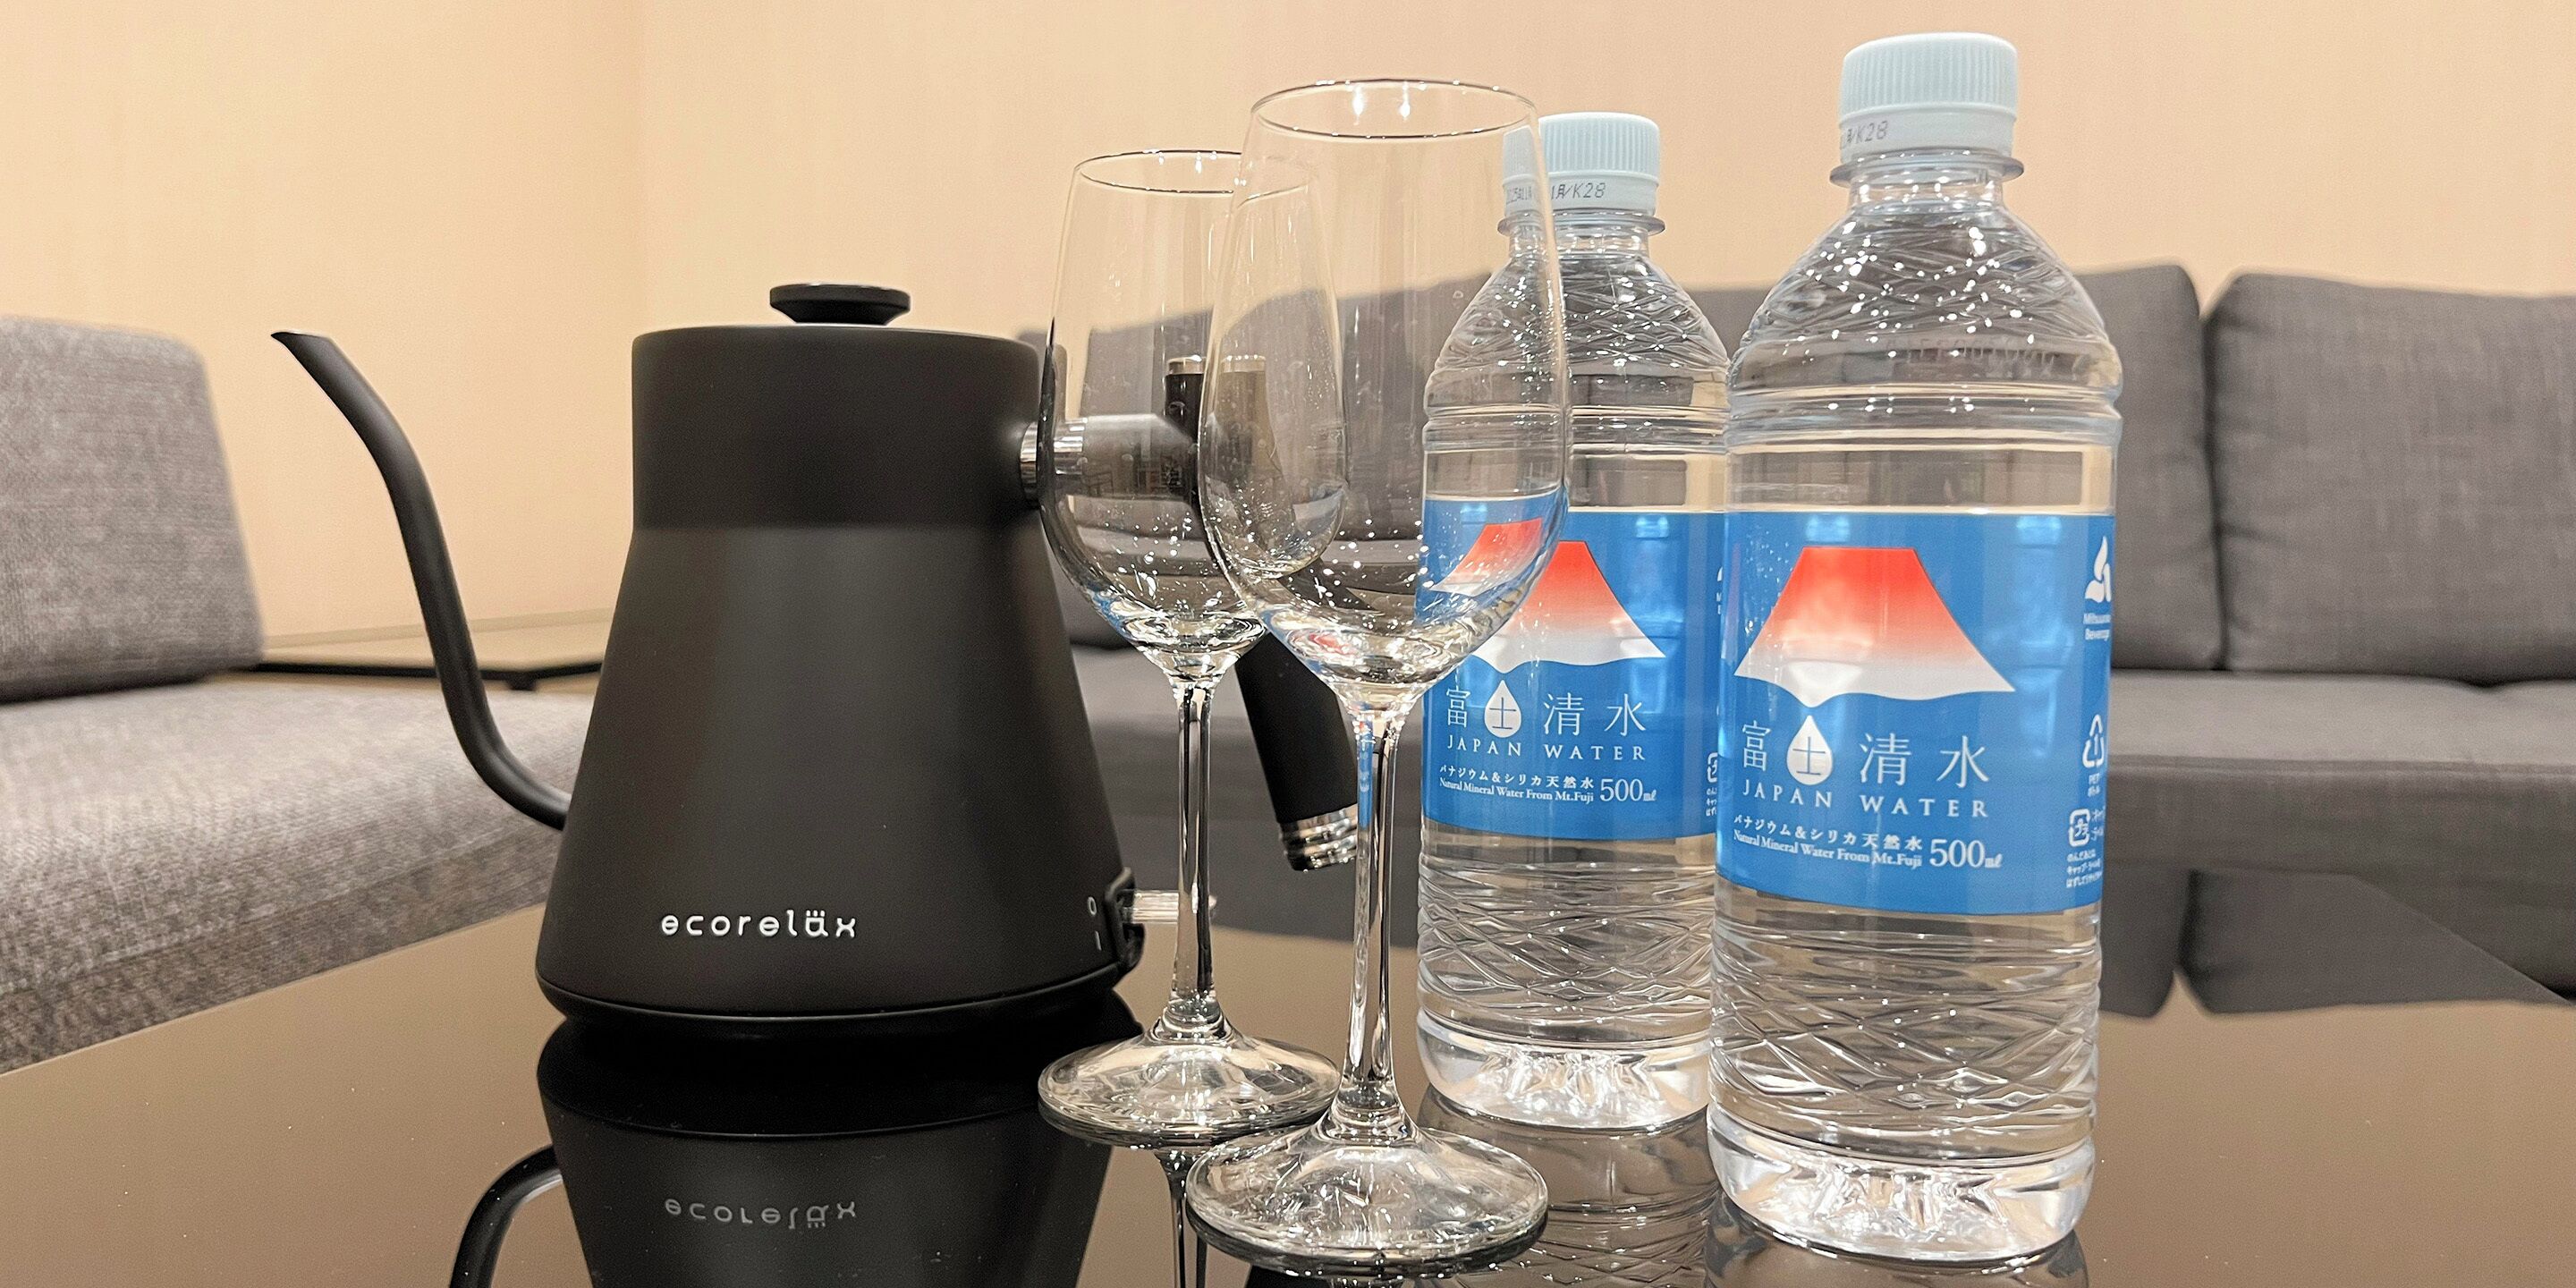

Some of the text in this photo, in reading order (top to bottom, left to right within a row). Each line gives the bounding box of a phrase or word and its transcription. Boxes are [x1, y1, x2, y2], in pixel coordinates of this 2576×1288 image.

[1445, 685, 1646, 736] 富士清水
[1447, 734, 1646, 760] JAPAN WATER
[1741, 719, 1989, 789] 富士清水
[1439, 777, 1594, 804] Natural Mineral Water From Mt.Fuji
[1742, 779, 1988, 818] JAPAN WATER
[1733, 828, 1923, 870] Natural Mineral Water From Mt.Fuji
